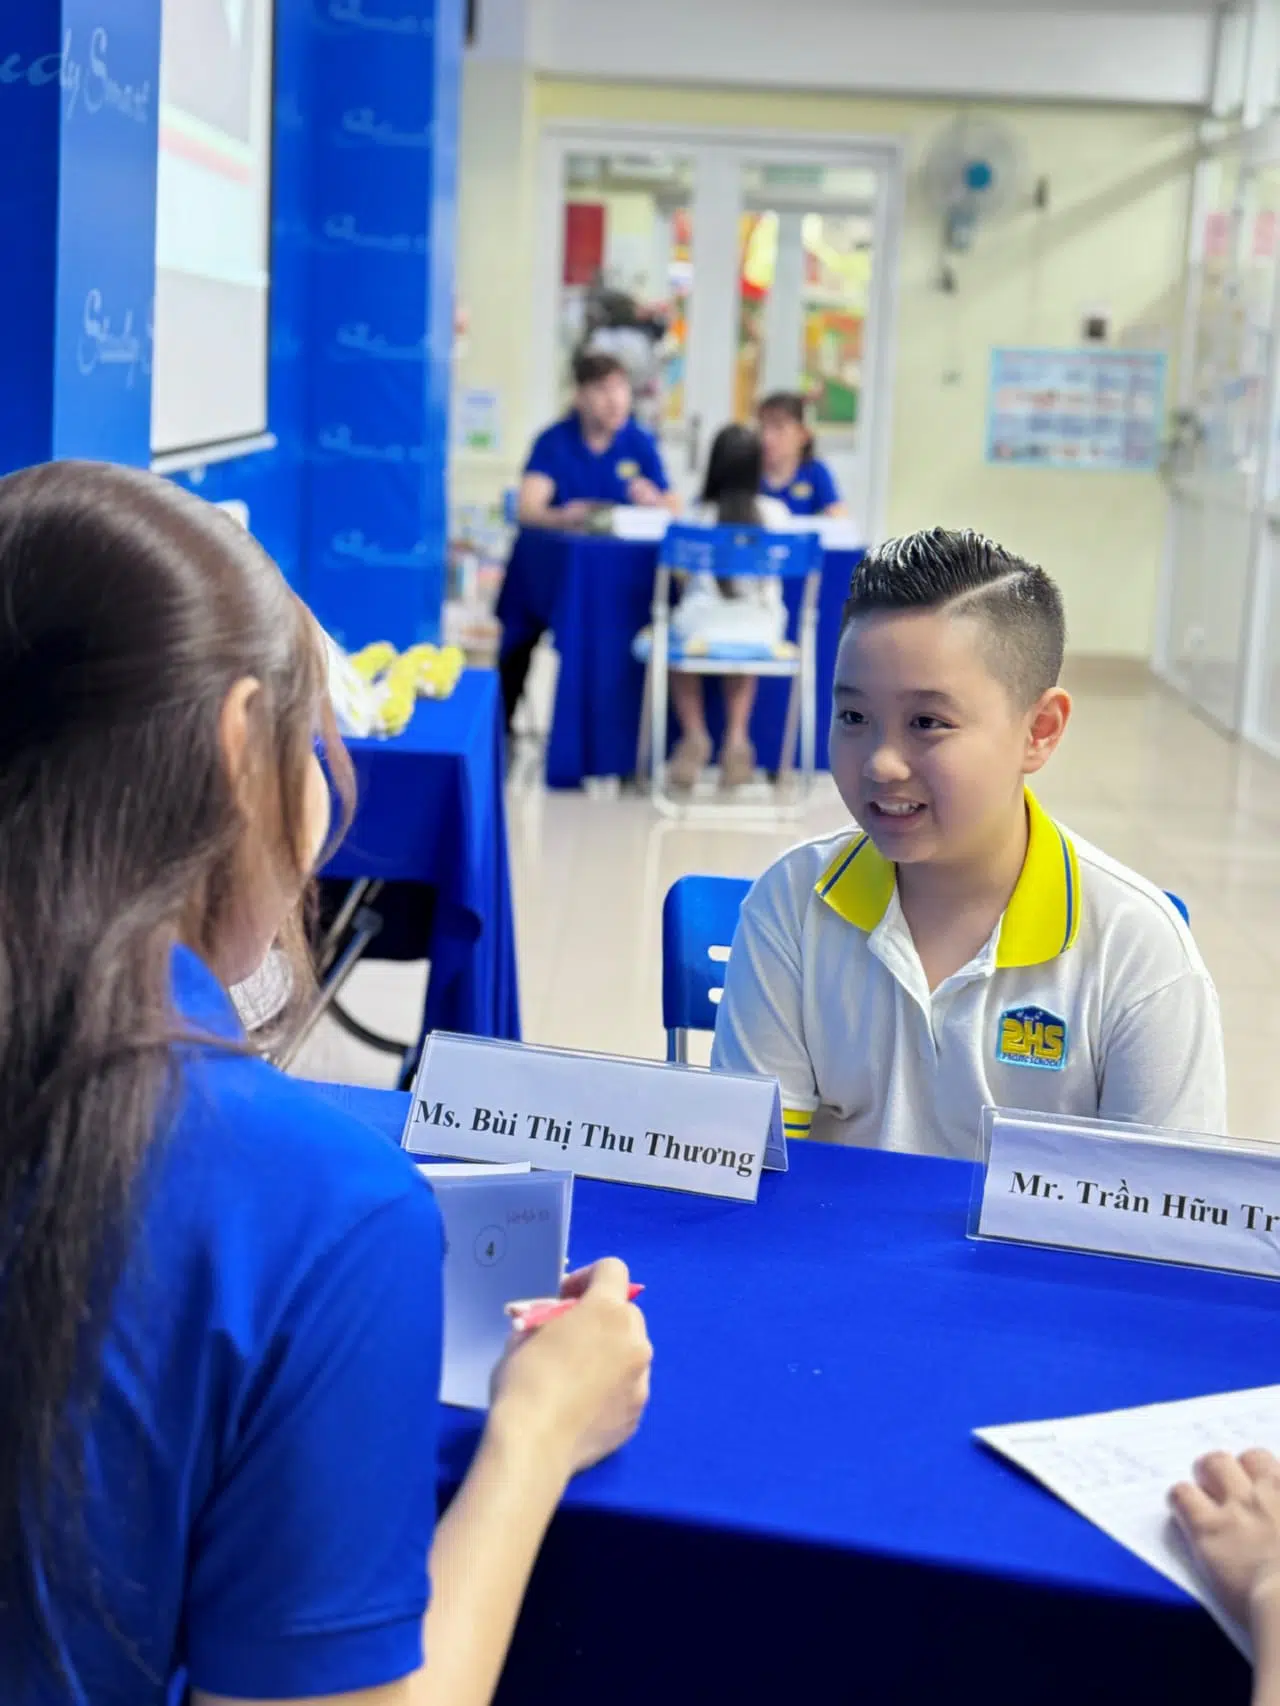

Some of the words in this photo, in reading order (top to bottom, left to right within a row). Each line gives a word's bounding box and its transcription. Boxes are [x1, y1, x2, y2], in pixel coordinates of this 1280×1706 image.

[1001, 1018, 1064, 1061] 2HS
[414, 1100, 461, 1129] Ms.
[469, 1107, 518, 1137] Bùi
[526, 1114, 572, 1151] Thị
[580, 1122, 635, 1154] Thu
[645, 1131, 756, 1177] Thương
[1008, 1171, 1064, 1202] Mr.
[1076, 1179, 1150, 1214] Trần
[1161, 1193, 1229, 1227] Hữu
